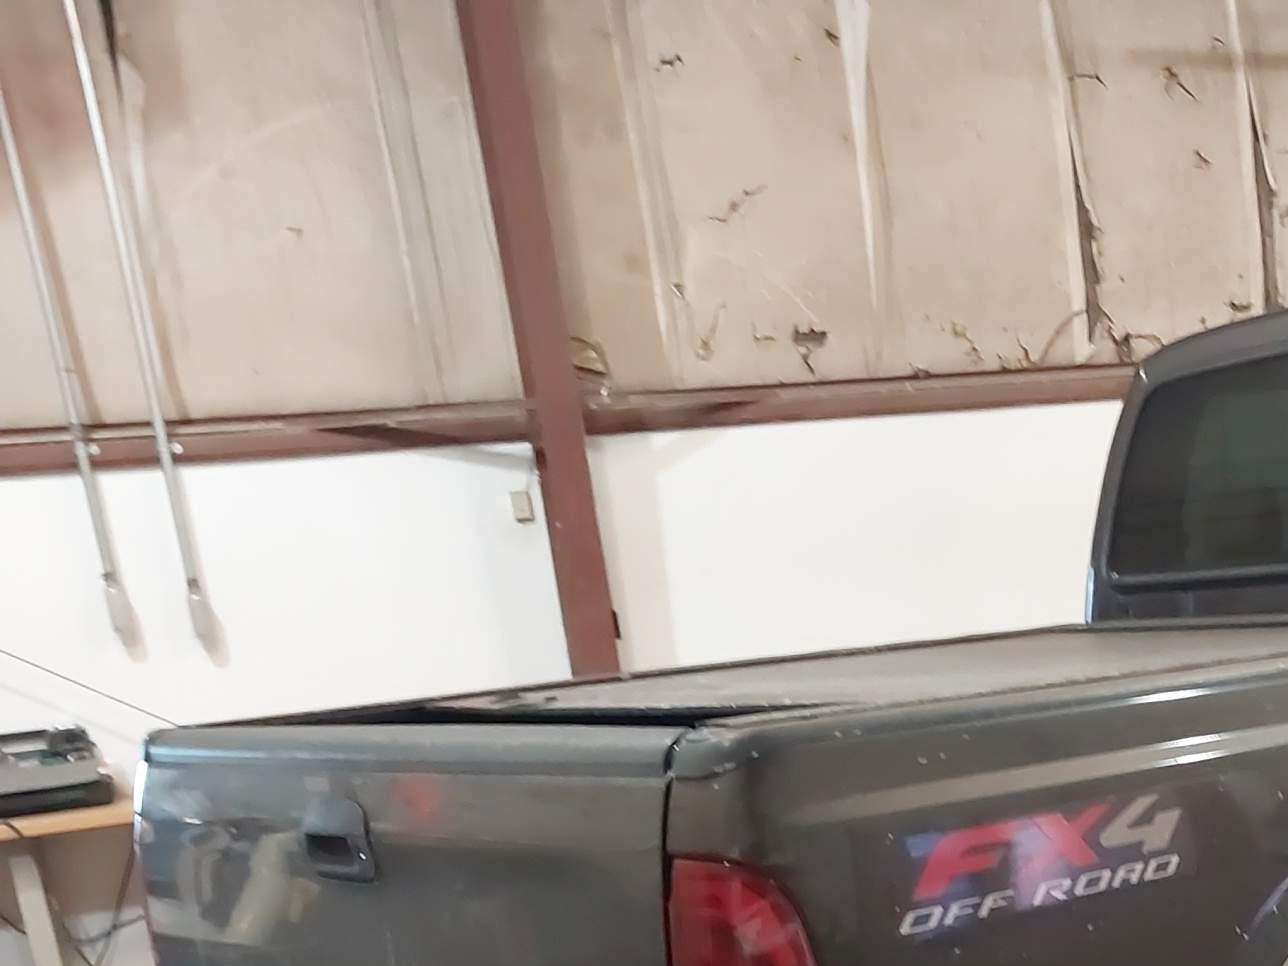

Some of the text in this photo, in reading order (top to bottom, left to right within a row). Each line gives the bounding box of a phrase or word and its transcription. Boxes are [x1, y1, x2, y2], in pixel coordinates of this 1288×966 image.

[899, 854, 1181, 937] OFF ROAD
[911, 794, 1182, 902] FX4
